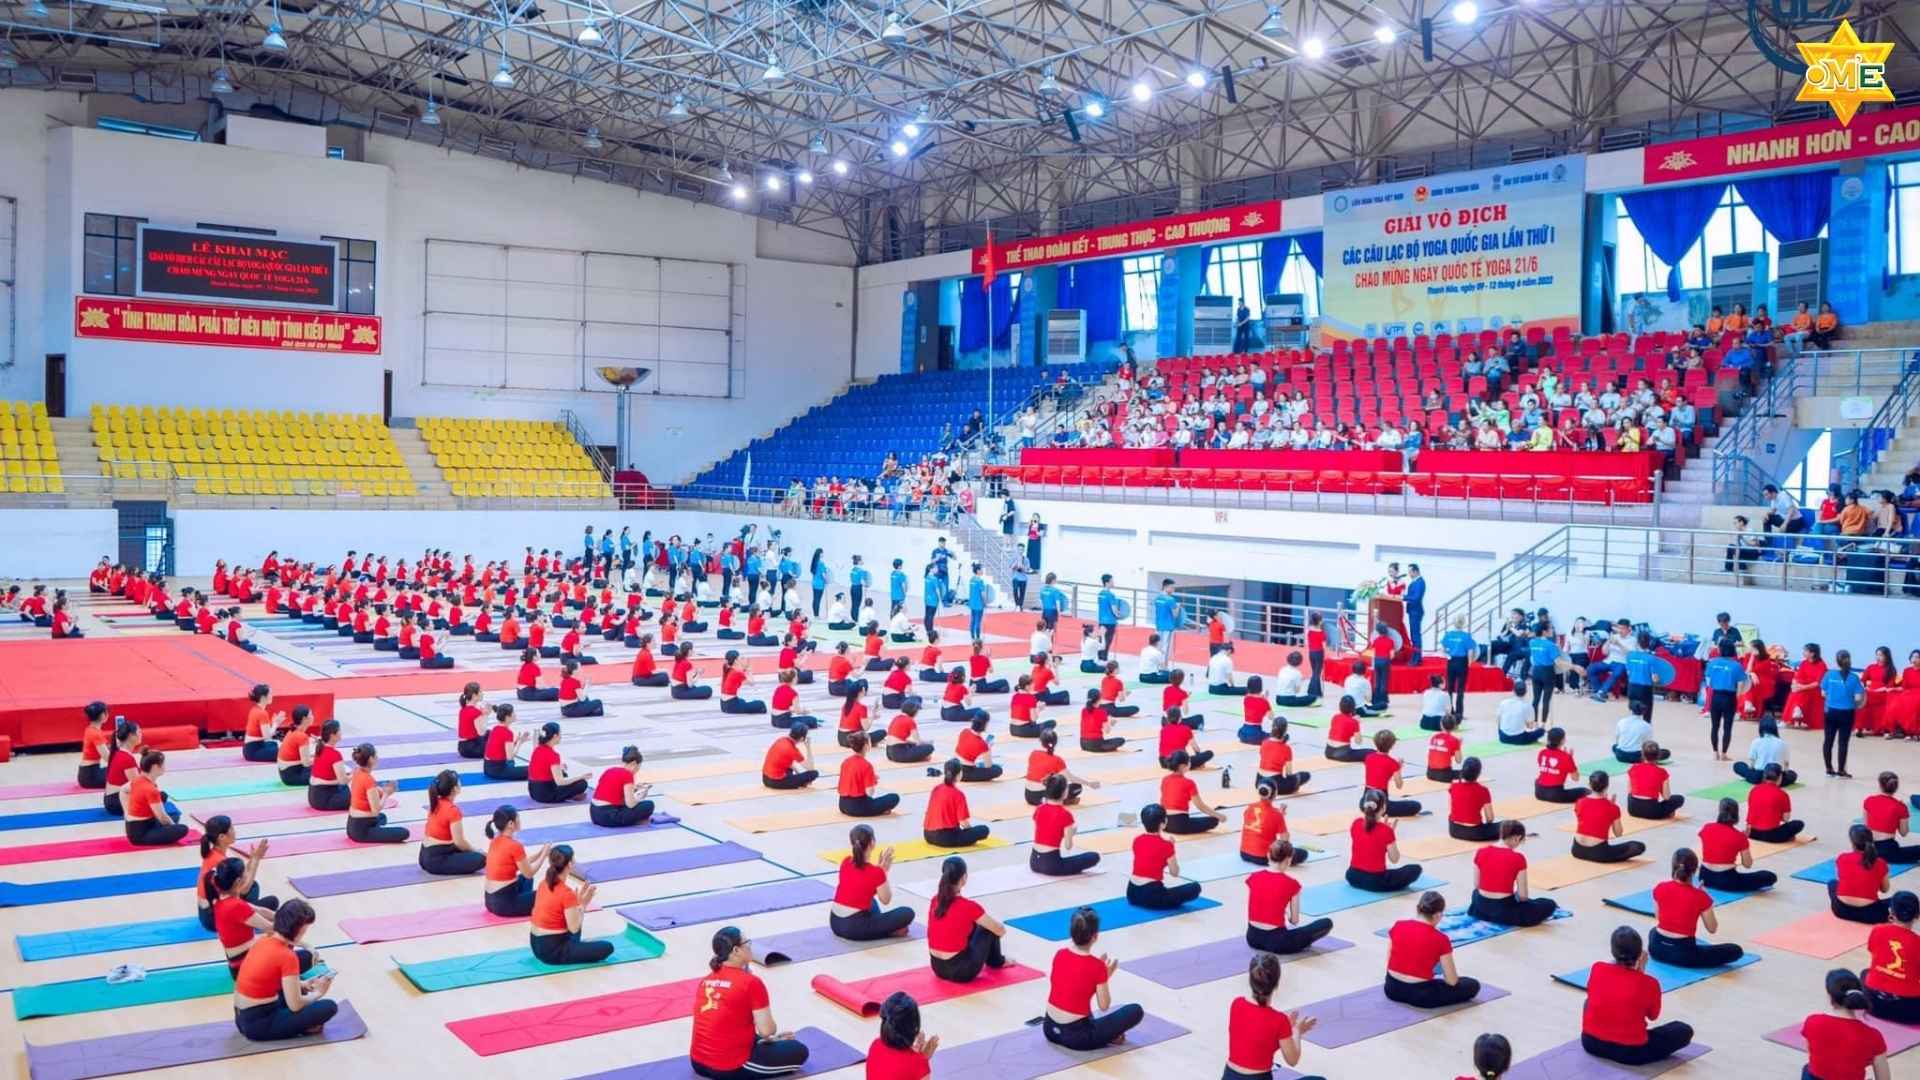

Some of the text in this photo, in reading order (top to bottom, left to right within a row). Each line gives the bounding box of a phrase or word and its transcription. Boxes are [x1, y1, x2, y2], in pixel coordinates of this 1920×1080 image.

[1727, 136, 1799, 165] NHANH
[1806, 129, 1852, 155] HƠN
[1427, 208, 1452, 229] VÔ
[1458, 204, 1507, 228] ĐỊCH
[215, 243, 251, 257] KHAI
[255, 248, 288, 261] MẠC
[1023, 246, 1044, 261] THAO
[1072, 234, 1089, 254] KẾT
[1097, 233, 1128, 251] TRUNG
[1164, 224, 1186, 240] CAO
[1385, 244, 1404, 264] LẠC
[1406, 240, 1420, 262] BỘ
[1423, 239, 1448, 257] YOGA
[1451, 230, 1478, 255] QUỐC
[1481, 233, 1500, 251] GIA
[1486, 258, 1511, 277] YOGA
[1515, 255, 1538, 274] 21/6
[145, 311, 177, 331] THANH
